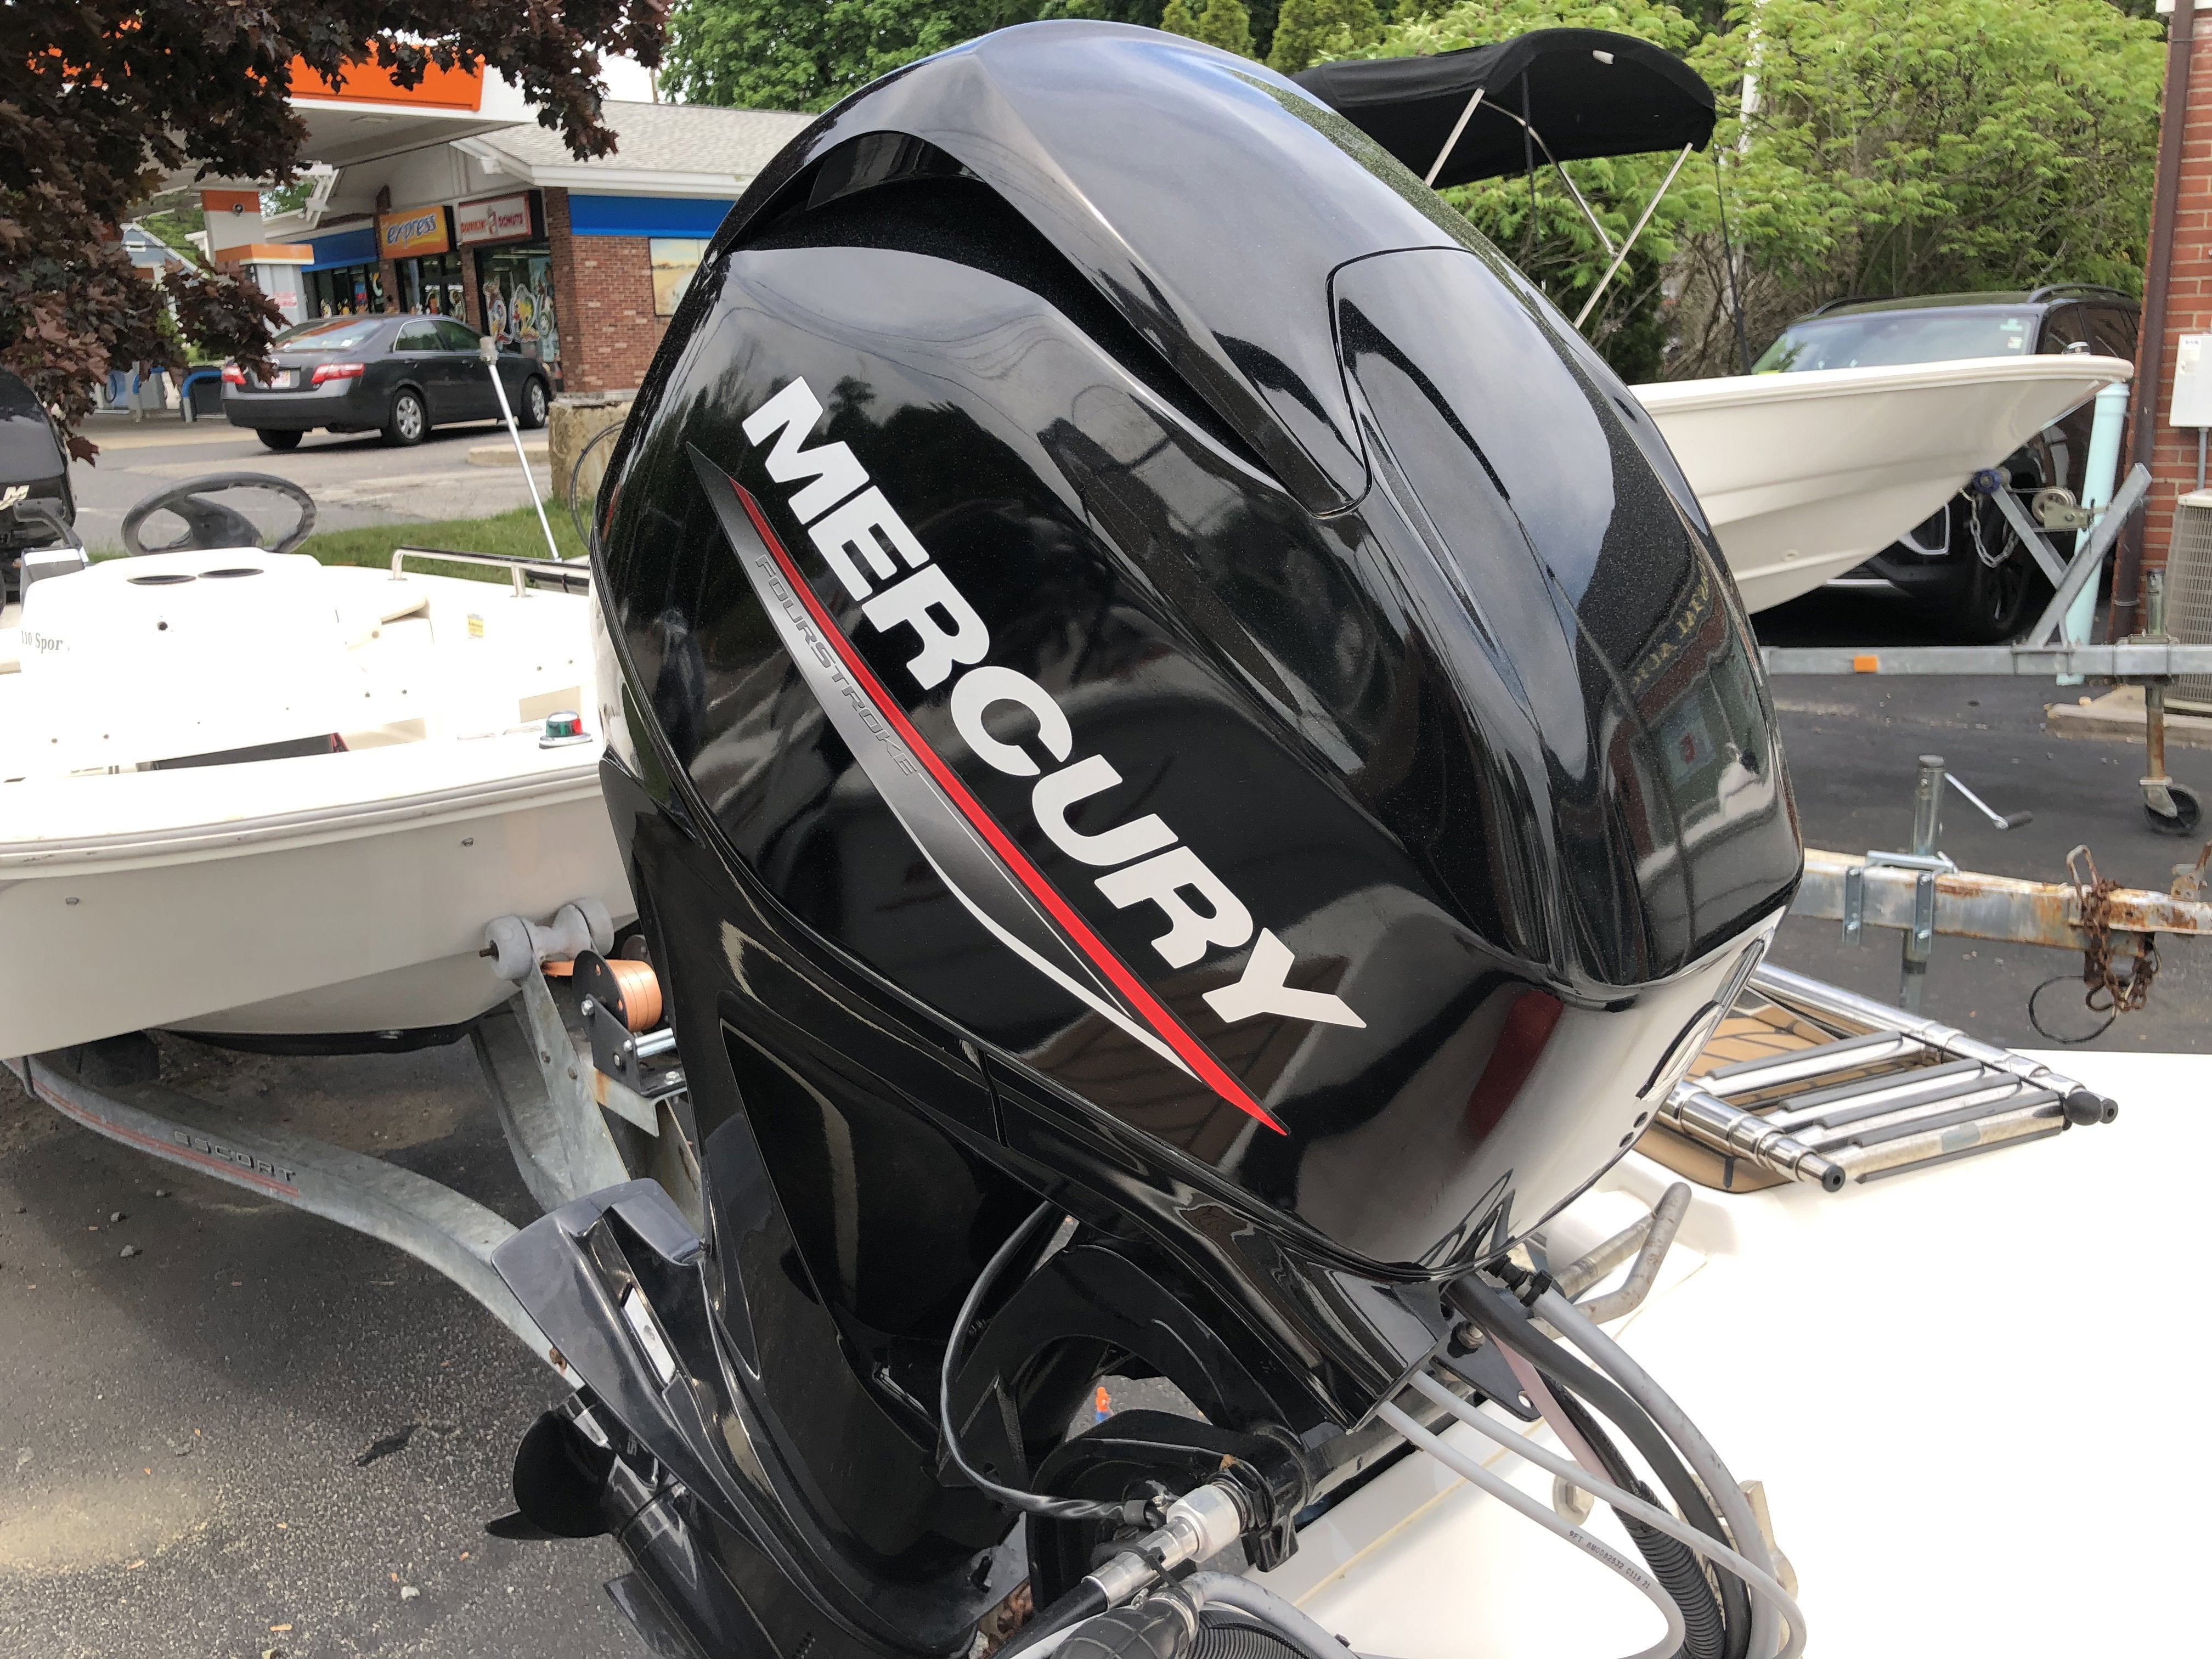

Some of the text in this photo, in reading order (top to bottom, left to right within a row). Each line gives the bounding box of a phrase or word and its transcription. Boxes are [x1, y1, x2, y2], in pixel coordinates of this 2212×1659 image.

[387, 213, 437, 250] express
[36, 633, 70, 654] Spor
[755, 555, 917, 775] FOURSTROKE
[742, 376, 1367, 1029] MERCURY
[1569, 1531, 1583, 1542] 9FT
[1642, 1581, 1650, 1589] 21
